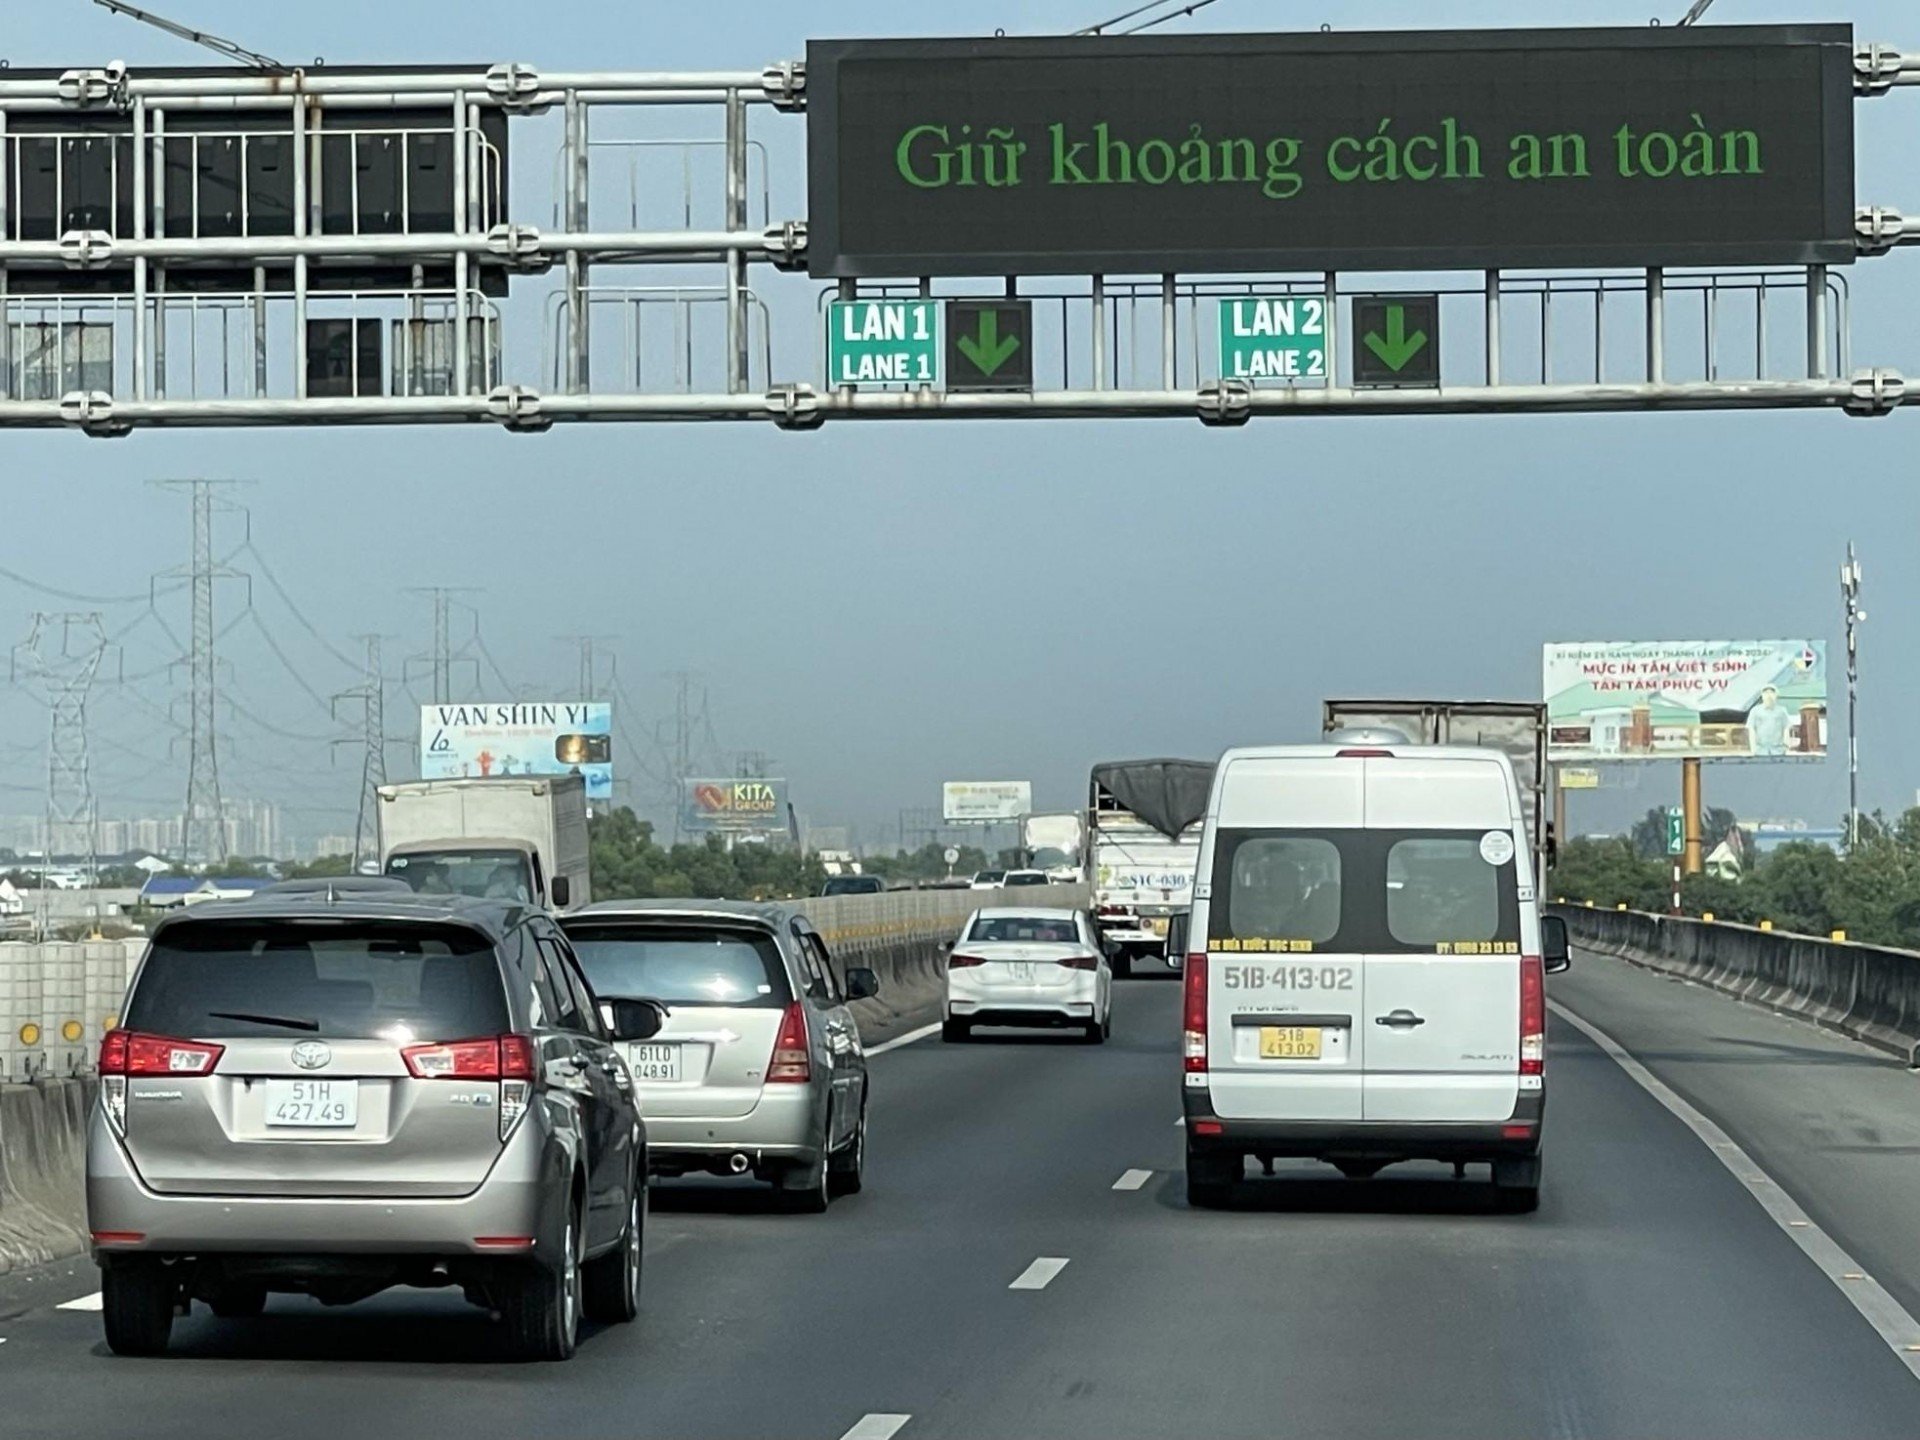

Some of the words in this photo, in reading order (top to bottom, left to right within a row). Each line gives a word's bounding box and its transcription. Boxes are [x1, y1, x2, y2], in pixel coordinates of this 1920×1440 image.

[896, 124, 1026, 188] Giữ
[1049, 122, 1303, 199] khoảng
[1326, 117, 1484, 182] cách
[1507, 132, 1591, 180] an
[1613, 113, 1764, 178] toàn
[912, 305, 930, 340] 1
[1301, 299, 1323, 335] 2
[842, 353, 911, 380] LANE
[916, 353, 932, 380] 1
[1234, 349, 1301, 377] LANE
[1306, 349, 1324, 376] 2
[1621, 662, 1637, 674] IN
[1712, 660, 1748, 673] SINH
[438, 705, 489, 726] VAN
[496, 704, 557, 726] SHIN
[564, 704, 589, 725] YI
[733, 783, 776, 801] KITA
[734, 800, 776, 812] GROUP
[1277, 1028, 1305, 1042] 51B
[1266, 1042, 1316, 1056] 413.02
[292, 1082, 331, 1101] 51H
[276, 1102, 345, 1121] 427.49
